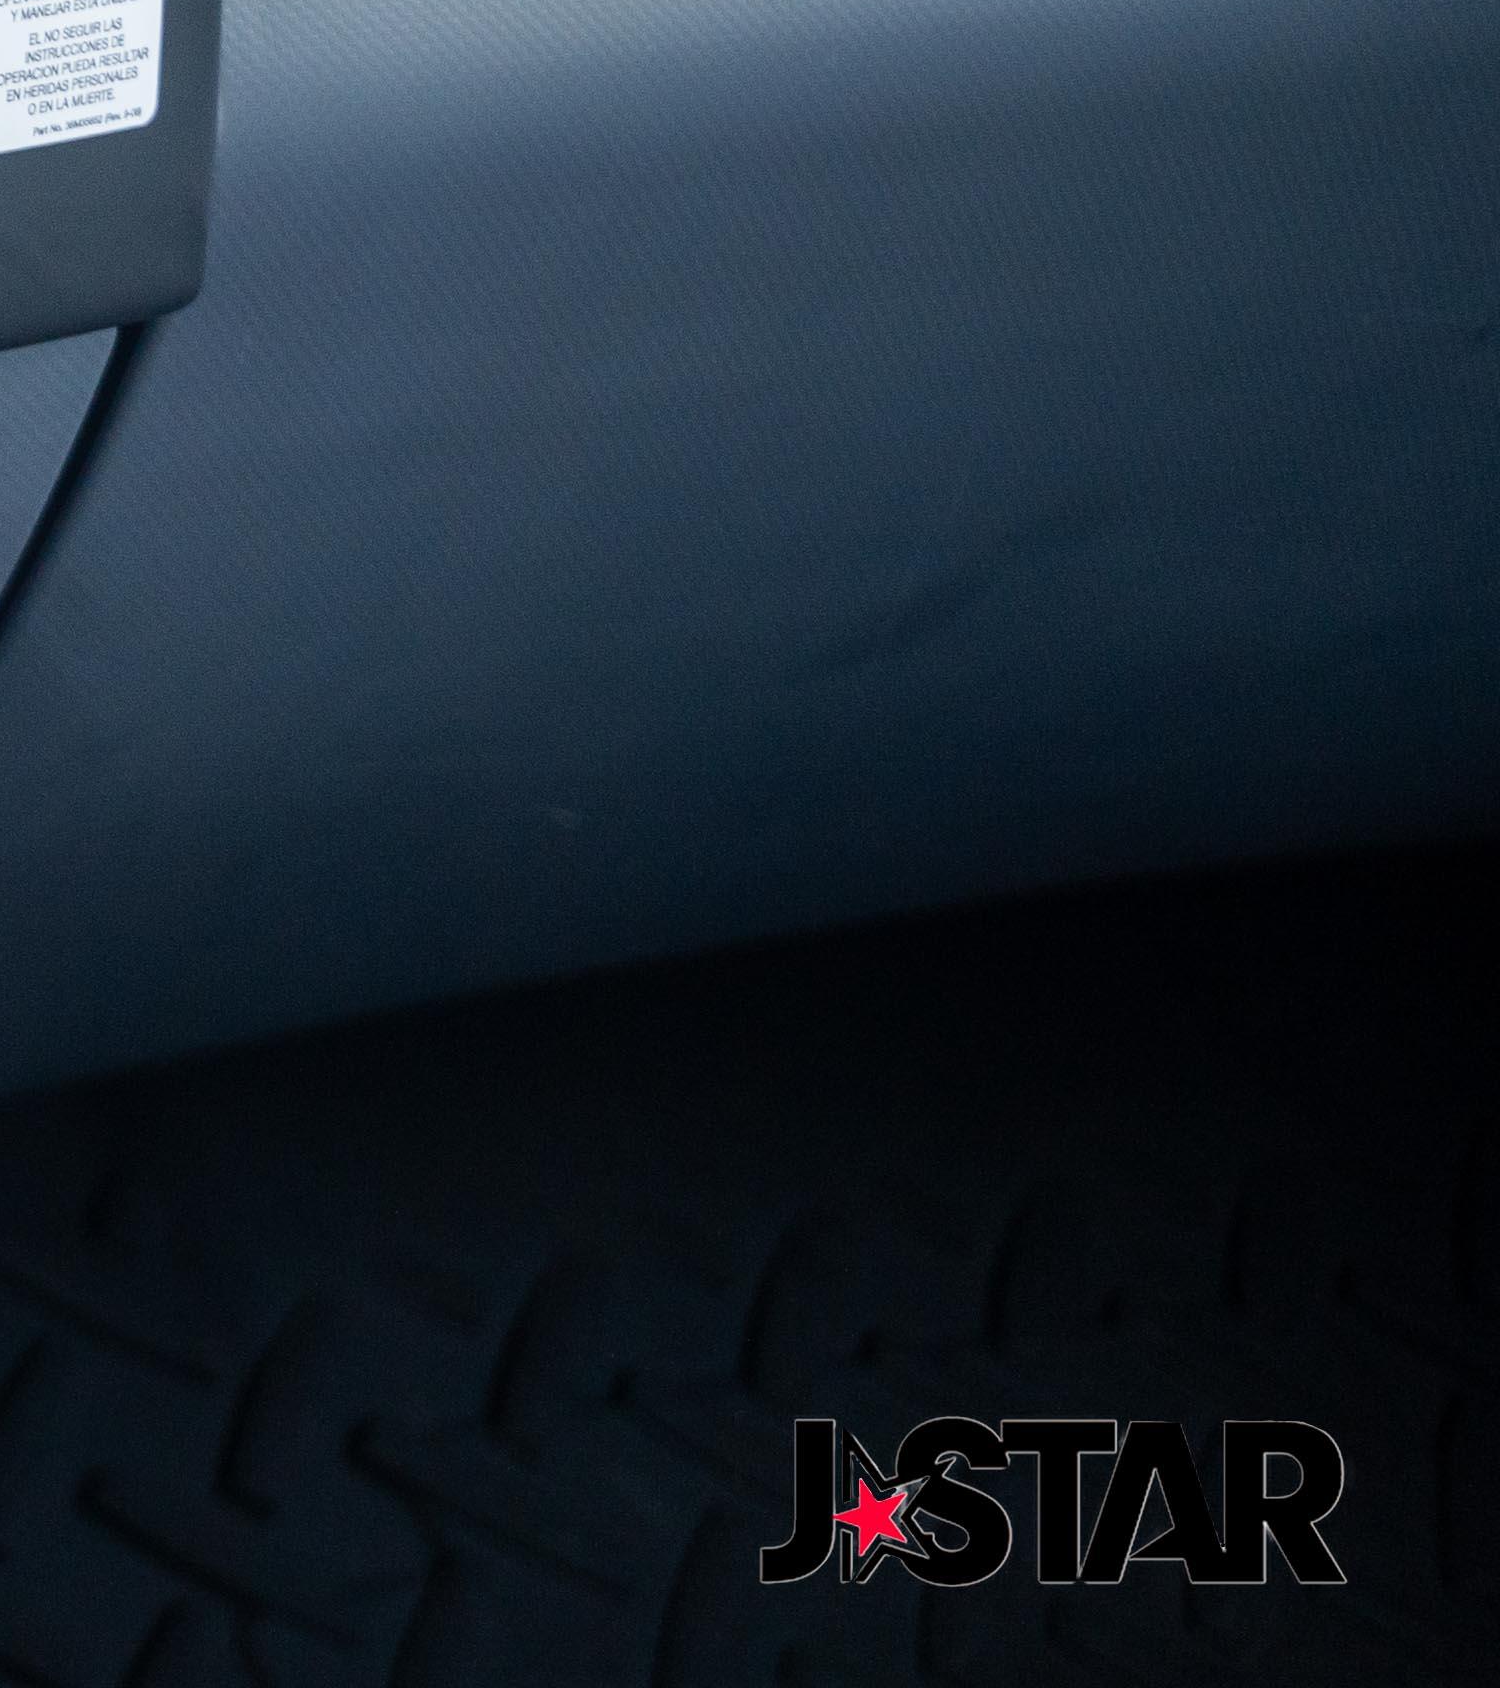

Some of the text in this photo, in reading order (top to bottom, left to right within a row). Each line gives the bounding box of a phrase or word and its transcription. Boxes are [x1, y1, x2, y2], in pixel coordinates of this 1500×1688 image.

[11, 10, 18, 21] Y
[21, 0, 70, 19] MANEJAR
[29, 17, 122, 45] EL NO SEGUIR LAS
[25, 34, 125, 64] INSTRUCCIONES DE
[62, 58, 96, 74] PUEDA
[100, 47, 150, 68] RESULTAR
[6, 66, 139, 102] EN HERIDAS PERSONALES
[28, 103, 36, 115] O
[39, 100, 53, 113] EN
[55, 97, 69, 110] LA
